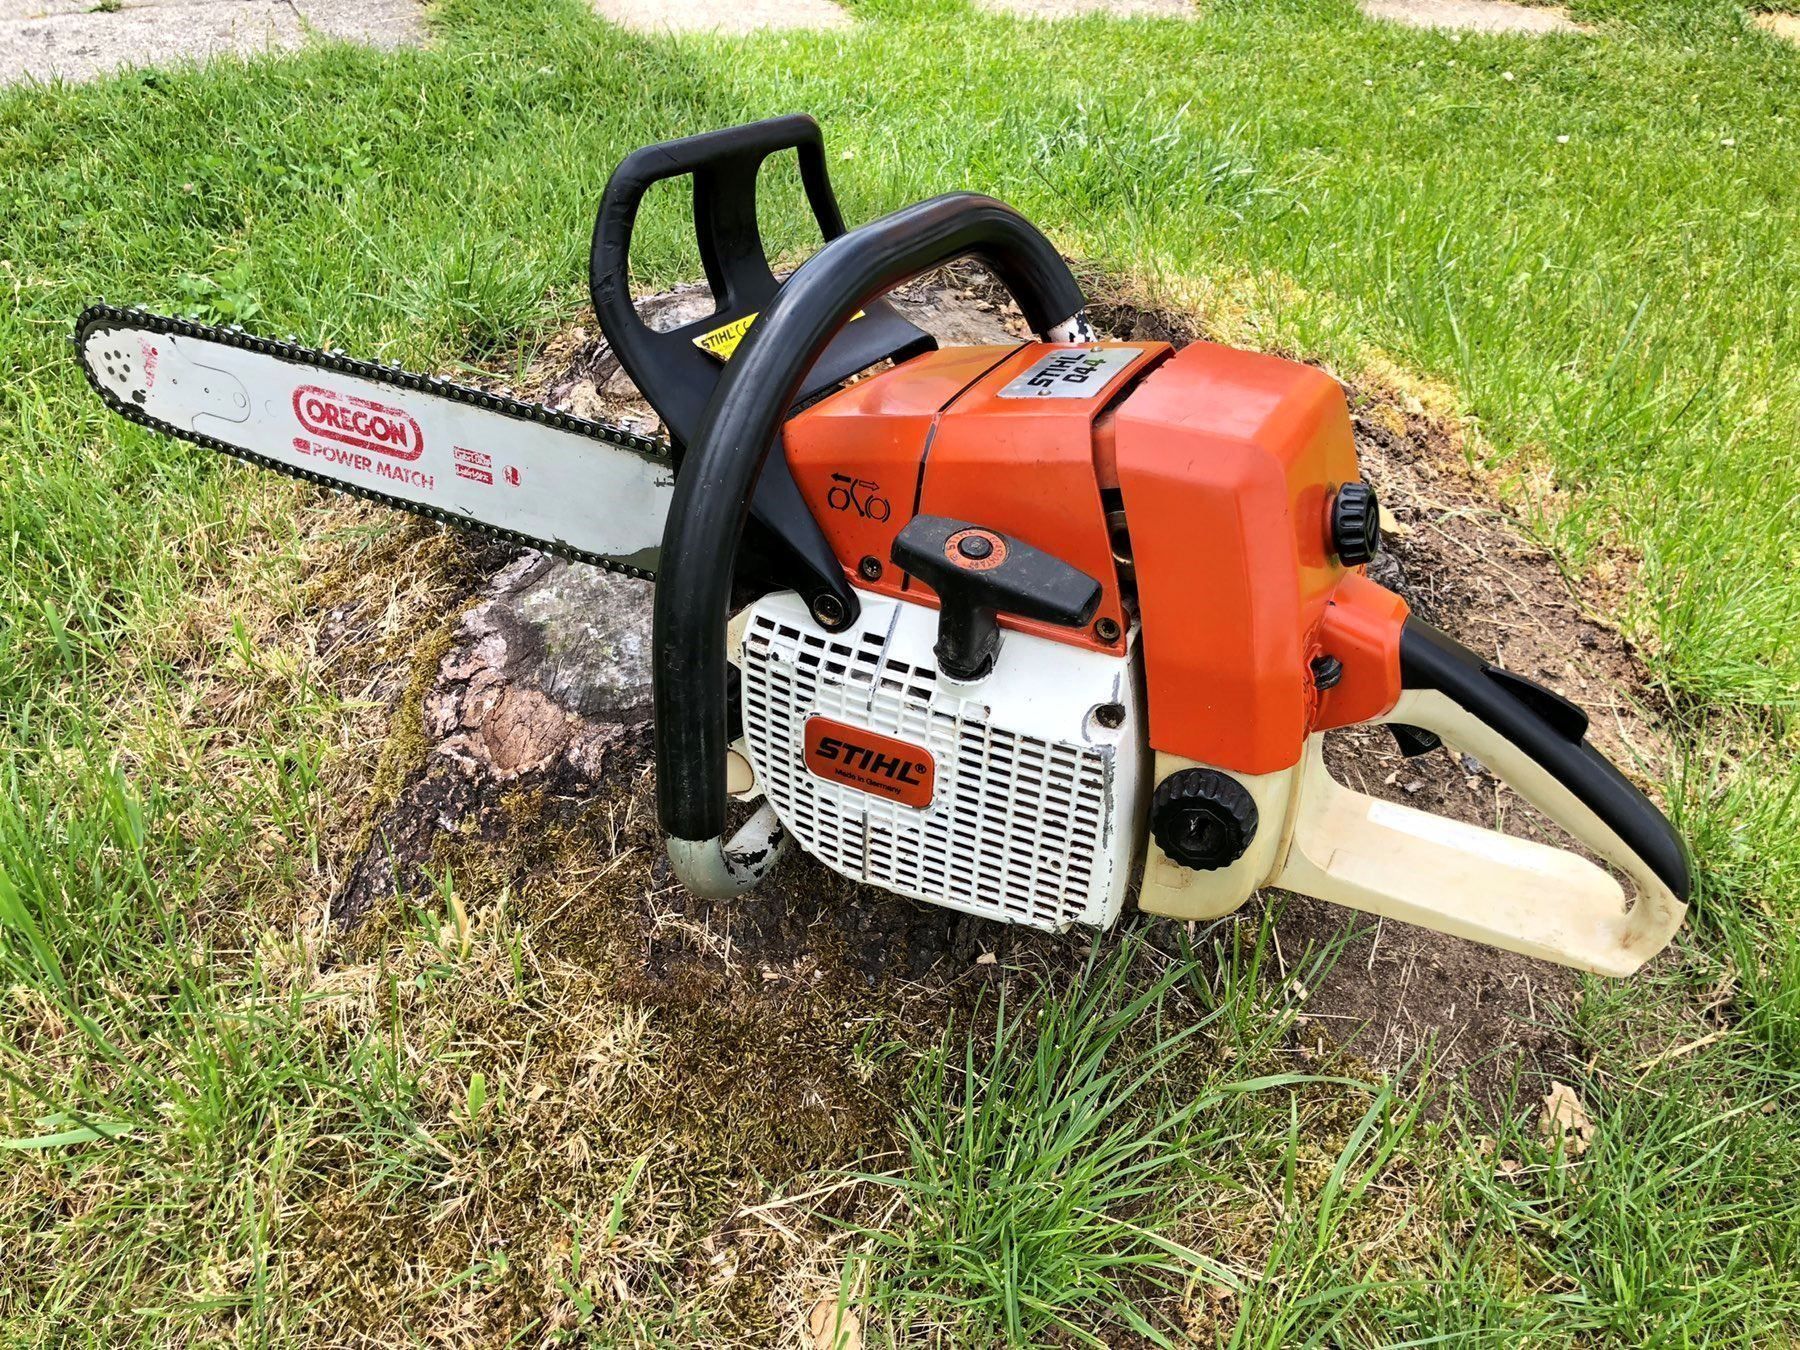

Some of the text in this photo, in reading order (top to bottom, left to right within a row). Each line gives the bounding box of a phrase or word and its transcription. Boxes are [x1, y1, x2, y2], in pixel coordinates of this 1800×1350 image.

[701, 329, 736, 349] STIHL
[1027, 354, 1086, 387] STIHL
[1062, 359, 1107, 383] 044
[306, 398, 407, 447] OREGON
[312, 442, 373, 473] POWER
[376, 461, 435, 490] MATCH
[835, 768, 857, 781] Made
[865, 778, 902, 795] Germany
